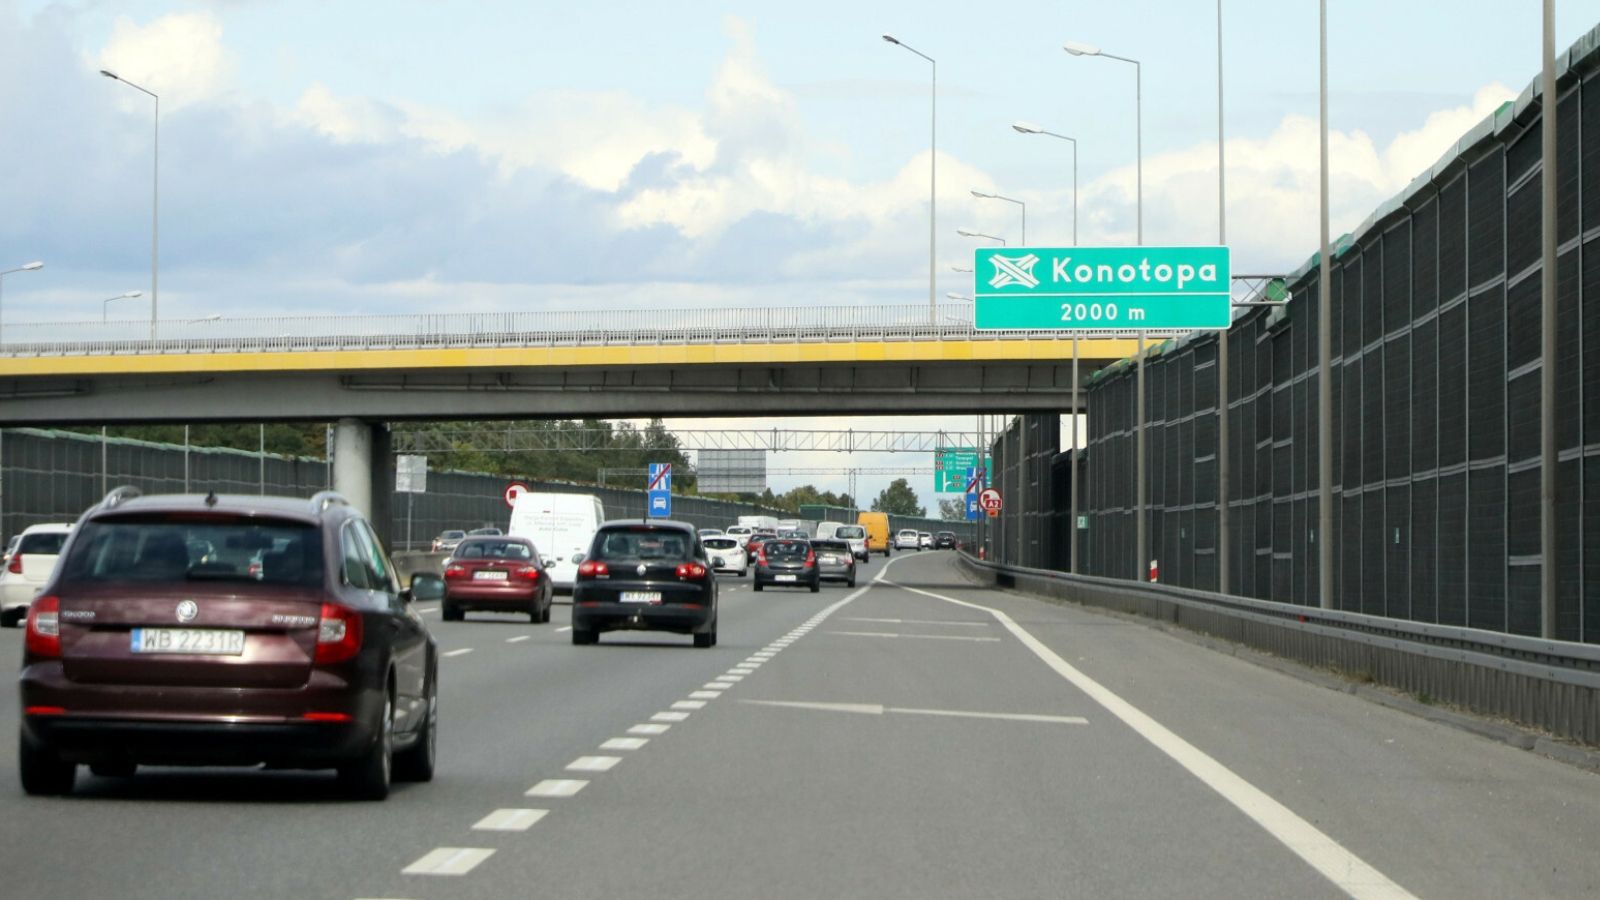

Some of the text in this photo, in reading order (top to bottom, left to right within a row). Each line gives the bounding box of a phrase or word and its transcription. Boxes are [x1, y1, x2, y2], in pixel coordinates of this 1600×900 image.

[1052, 257, 1217, 289] Konotopa
[1060, 303, 1145, 321] 2000 m
[988, 500, 999, 508] A2
[144, 630, 241, 649] WB 2231R
